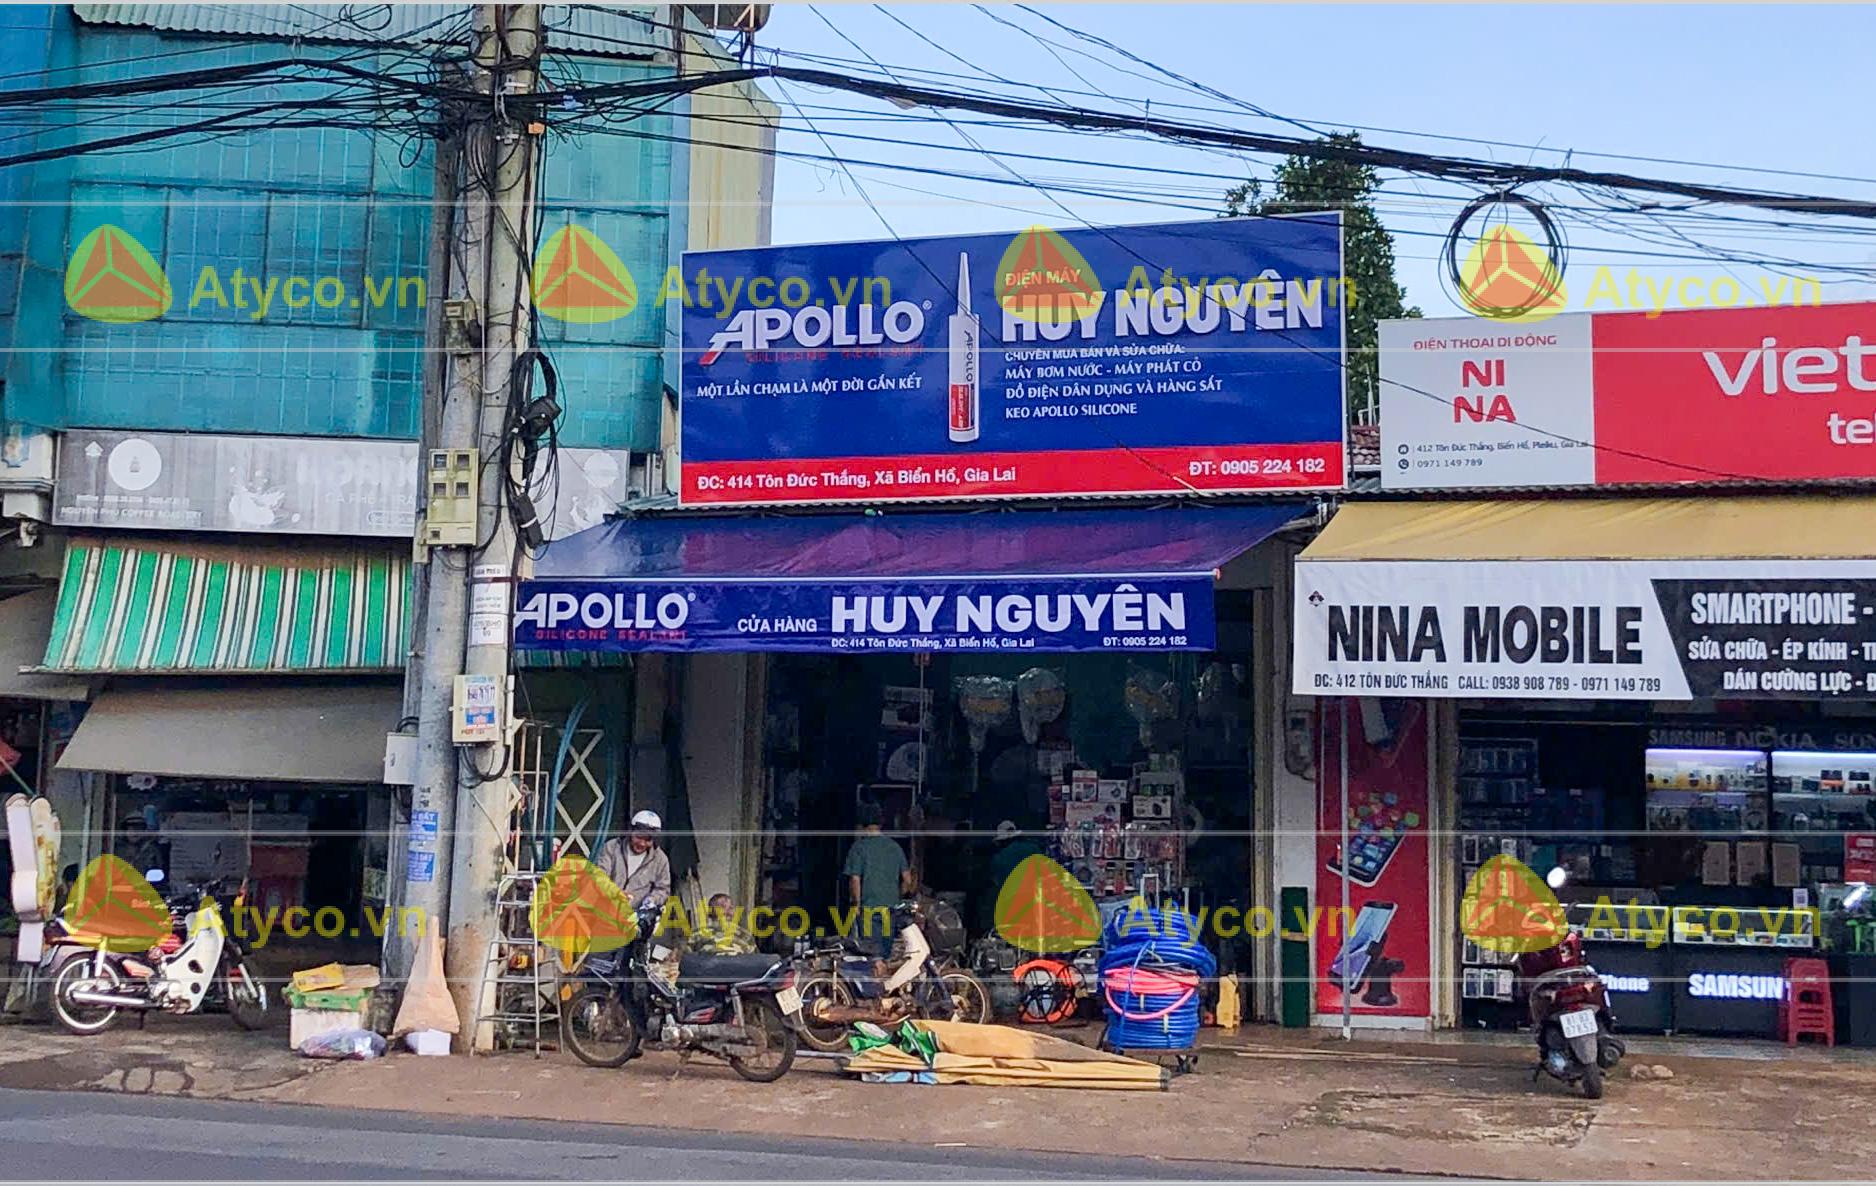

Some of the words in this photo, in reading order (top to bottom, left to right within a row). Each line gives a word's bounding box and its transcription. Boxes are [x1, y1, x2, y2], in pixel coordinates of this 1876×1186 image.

[1046, 268, 1081, 285] MÁY
[1002, 291, 1106, 342] HUY
[1115, 268, 1322, 336] NGUYÊN
[700, 300, 924, 366] APOLLO
[1497, 336, 1511, 347] DI
[1052, 348, 1078, 360] MUA
[1005, 363, 1033, 380] MÁY
[1036, 364, 1065, 378] BƠM
[1067, 362, 1103, 377] NƯỚC
[1114, 360, 1143, 375] MÁY
[1146, 357, 1180, 374] PHÁT
[1183, 356, 1202, 372] CỎ
[1462, 359, 1505, 388] NI
[696, 381, 722, 399] MỘT
[726, 377, 750, 396] LẦN
[753, 380, 791, 398] CHẠM
[793, 378, 808, 393] LÀ
[811, 377, 838, 395] MỘT
[841, 375, 864, 392] ĐỜI
[898, 372, 922, 389] KẾT
[1006, 383, 1025, 399] ĐỒ
[1028, 386, 1059, 400] ĐIỆN
[1062, 382, 1092, 397] DÂN
[1094, 382, 1133, 397] DỤNG
[1136, 379, 1154, 394] VÀ
[1157, 377, 1197, 393] HÀNG
[1199, 375, 1223, 392] SẮT
[1005, 407, 1030, 419] KEO
[1033, 405, 1079, 417] APOLLO
[1081, 402, 1138, 415] SILICONE
[1453, 395, 1517, 424] NA
[1189, 461, 1217, 476] ĐT:
[1220, 460, 1259, 475] 0905
[1262, 459, 1292, 474] 224
[1296, 458, 1325, 473] 182
[1417, 460, 1440, 468] 0971
[1445, 459, 1462, 467] 149
[1464, 458, 1483, 466] 789
[698, 475, 725, 490] ĐC:
[727, 473, 753, 488] 414
[756, 472, 783, 488] Tôn
[786, 470, 817, 487] Đức
[820, 468, 871, 487] Thắng,
[874, 469, 894, 484] Xã
[964, 467, 990, 482] Gia
[993, 466, 1016, 481] Lai
[512, 592, 689, 630] APOLLO
[831, 597, 943, 633] HUY
[956, 583, 1186, 632] NGUYÊN
[1691, 592, 1857, 625] SMARTPHONE
[738, 613, 771, 633] CỬA
[774, 613, 818, 633] HÀNG
[1328, 605, 1447, 662] NINA
[1463, 605, 1643, 664] MOBILE
[850, 638, 866, 648] 414
[1001, 637, 1018, 648] Gia
[1019, 637, 1035, 648] Lai
[1122, 636, 1147, 647] 0905
[1148, 636, 1166, 646] 224
[1169, 636, 1187, 646] 182
[1688, 636, 1721, 660] SỬA
[1724, 638, 1768, 660] CHỮA
[1782, 637, 1803, 660] ÉP
[1807, 637, 1848, 660] KÍNH
[1314, 674, 1333, 688] ĐC:
[1336, 674, 1356, 688] 412
[1360, 672, 1381, 689] TÔN
[1458, 676, 1489, 690] CALL:
[1492, 676, 1520, 691] 0938
[1523, 676, 1545, 691] 908
[1548, 676, 1570, 691] 789
[1581, 676, 1609, 692] 0971
[1614, 677, 1636, 692] 149
[1639, 677, 1661, 692] 789
[1723, 668, 1757, 690] DÁN
[1761, 667, 1817, 691] CƯỜNG
[1820, 671, 1852, 695] LỰC
[1649, 729, 1727, 746] SAMSUNG
[1689, 973, 1792, 1001] SAMSUN
